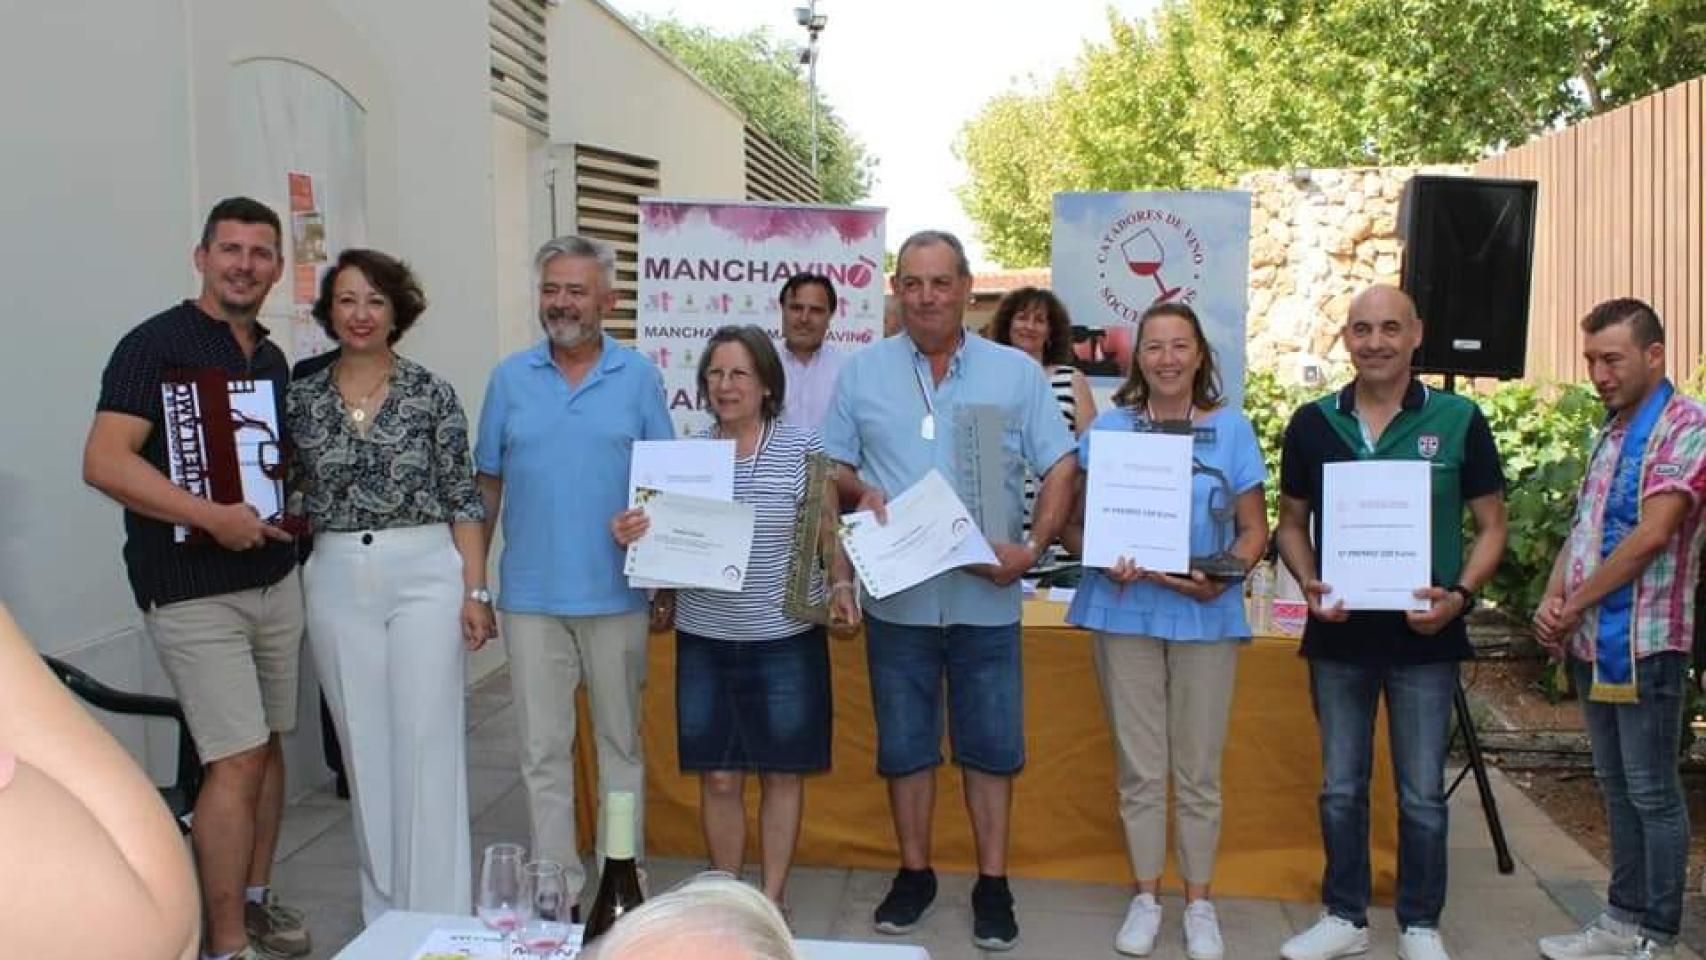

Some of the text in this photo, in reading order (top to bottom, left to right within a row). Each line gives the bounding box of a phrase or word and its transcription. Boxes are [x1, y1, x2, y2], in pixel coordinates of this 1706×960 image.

[1098, 209, 1204, 265] CATADORES DE VINO
[644, 326, 874, 344] MANCHA MAVINO
